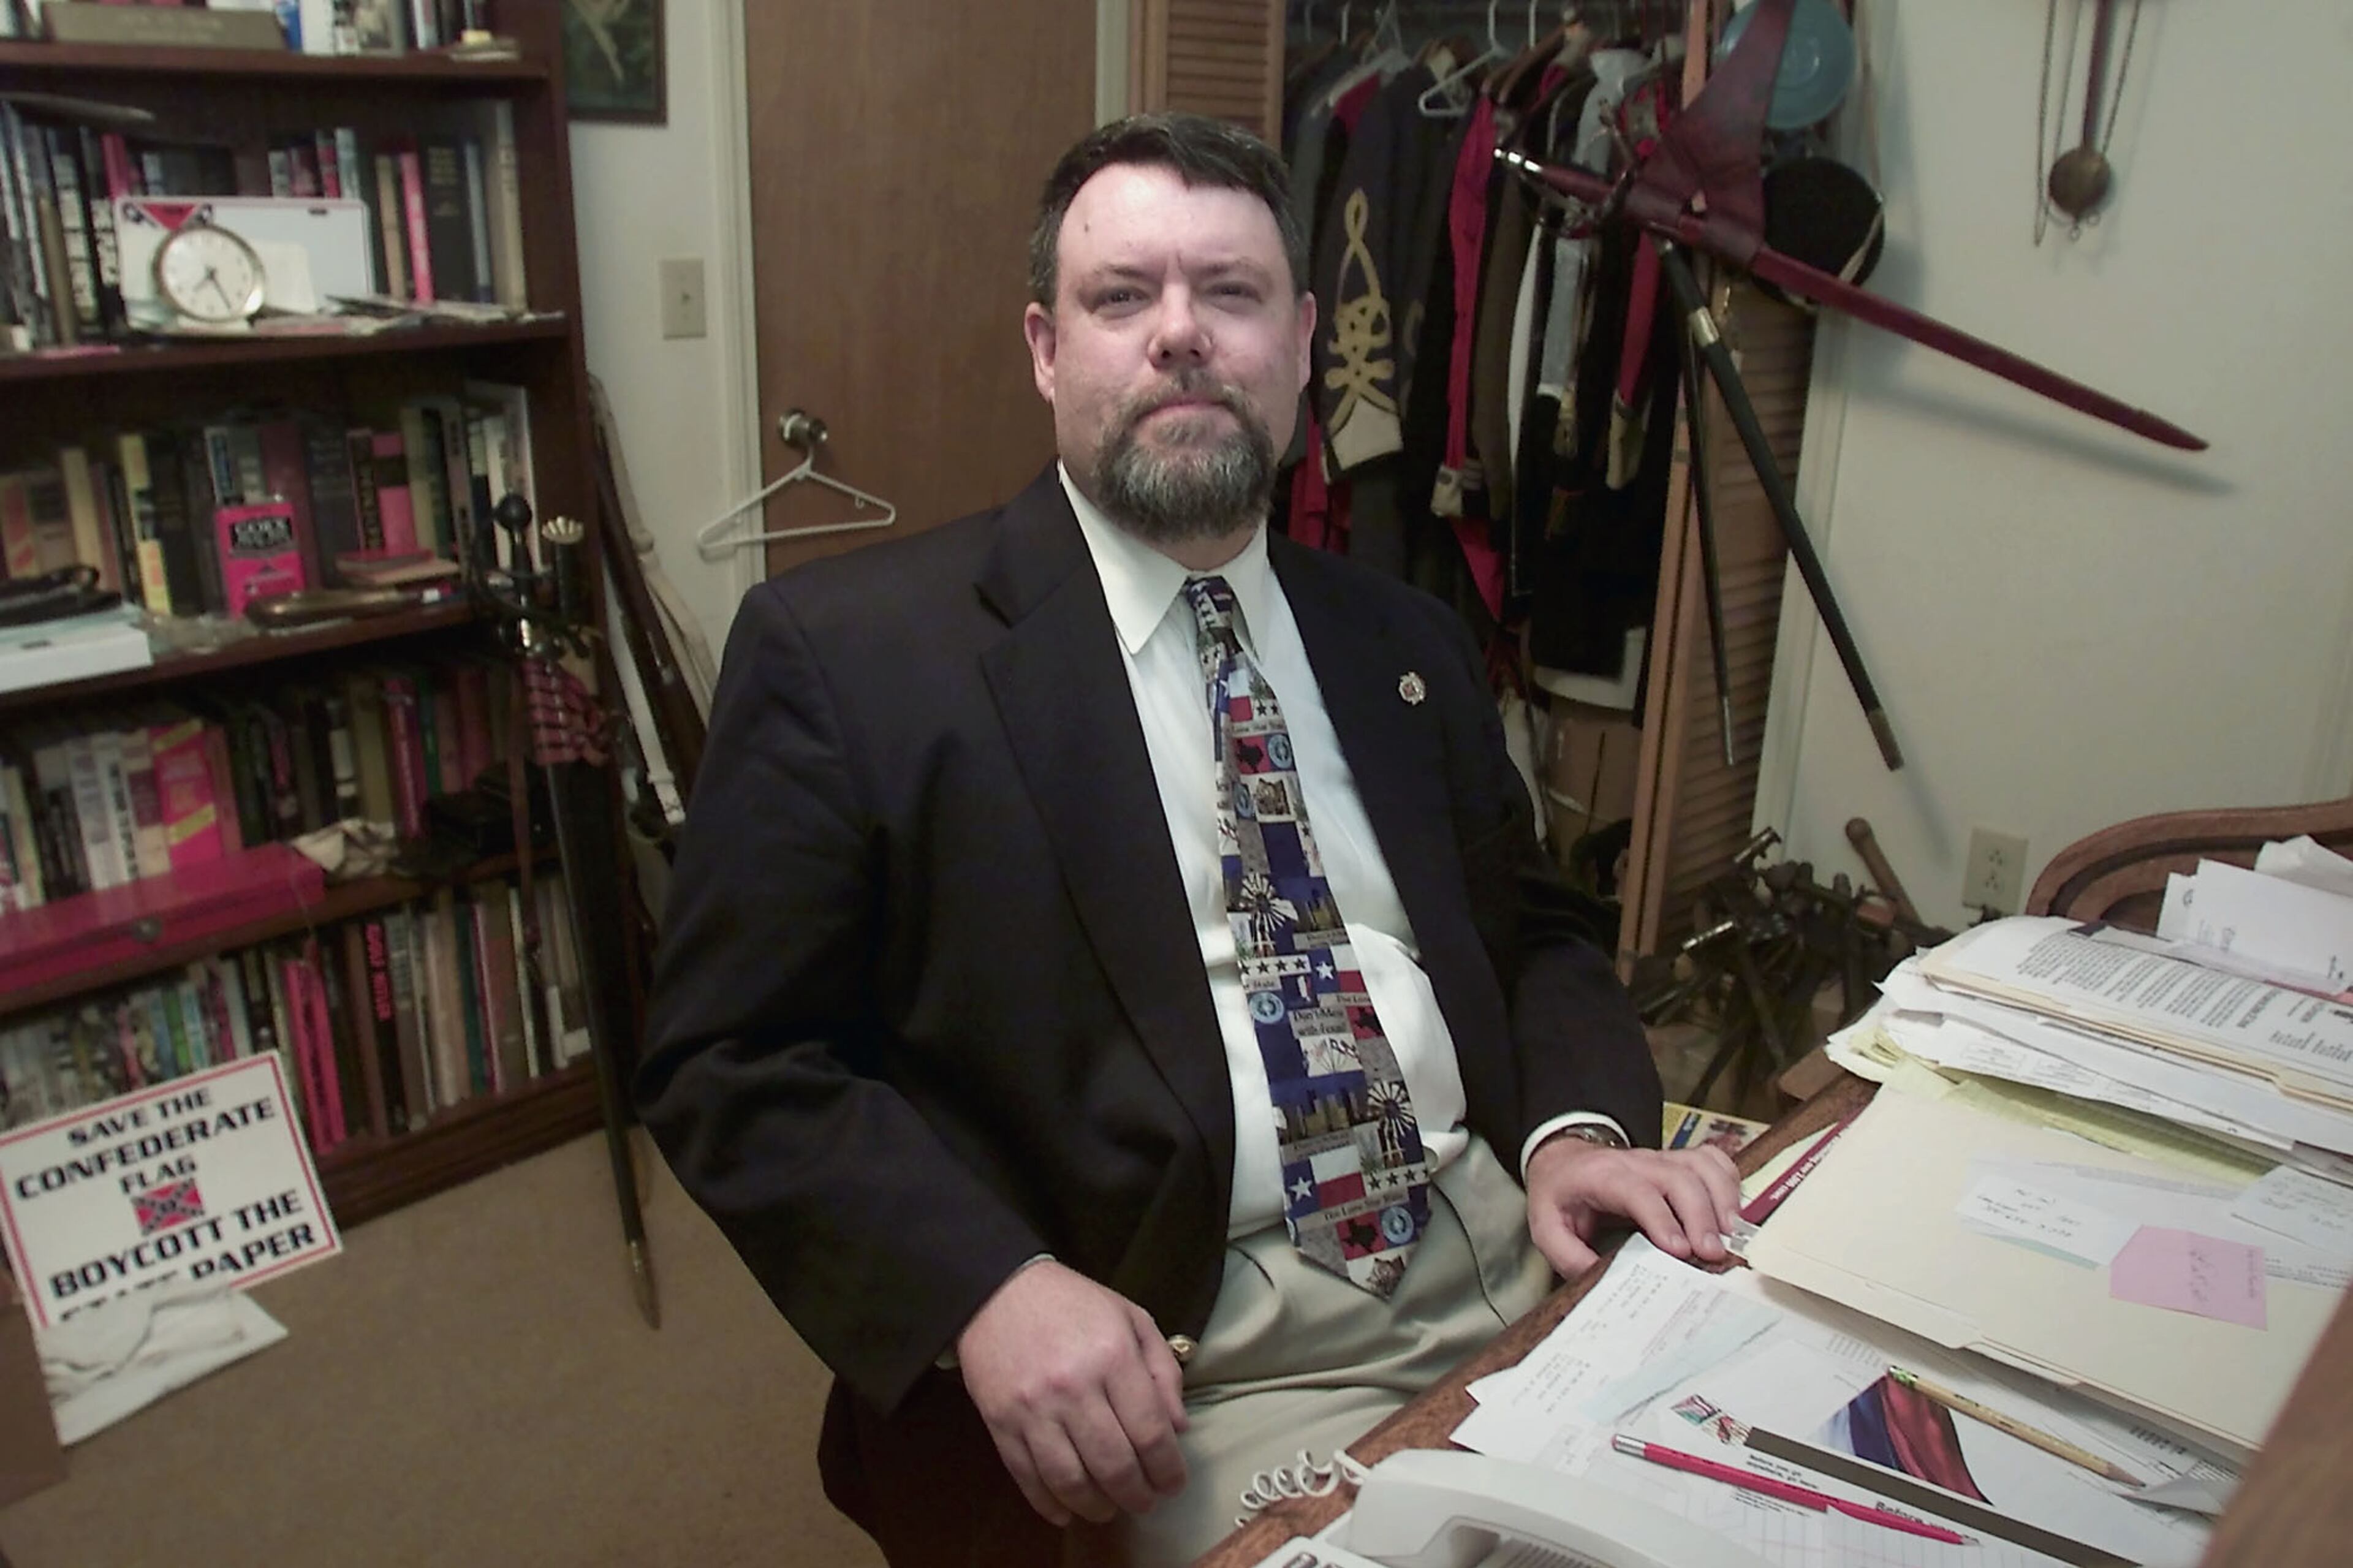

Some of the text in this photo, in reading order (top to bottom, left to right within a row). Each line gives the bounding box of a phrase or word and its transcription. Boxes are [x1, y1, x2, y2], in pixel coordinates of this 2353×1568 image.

[68, 1087, 211, 1148] SAVE THE
[15, 1097, 276, 1200] CONFEDERATE
[120, 1154, 197, 1197] FLAG
[50, 1217, 227, 1299] BOYCOTT
[231, 1189, 303, 1231] THE
[189, 1223, 316, 1280] PAPER
